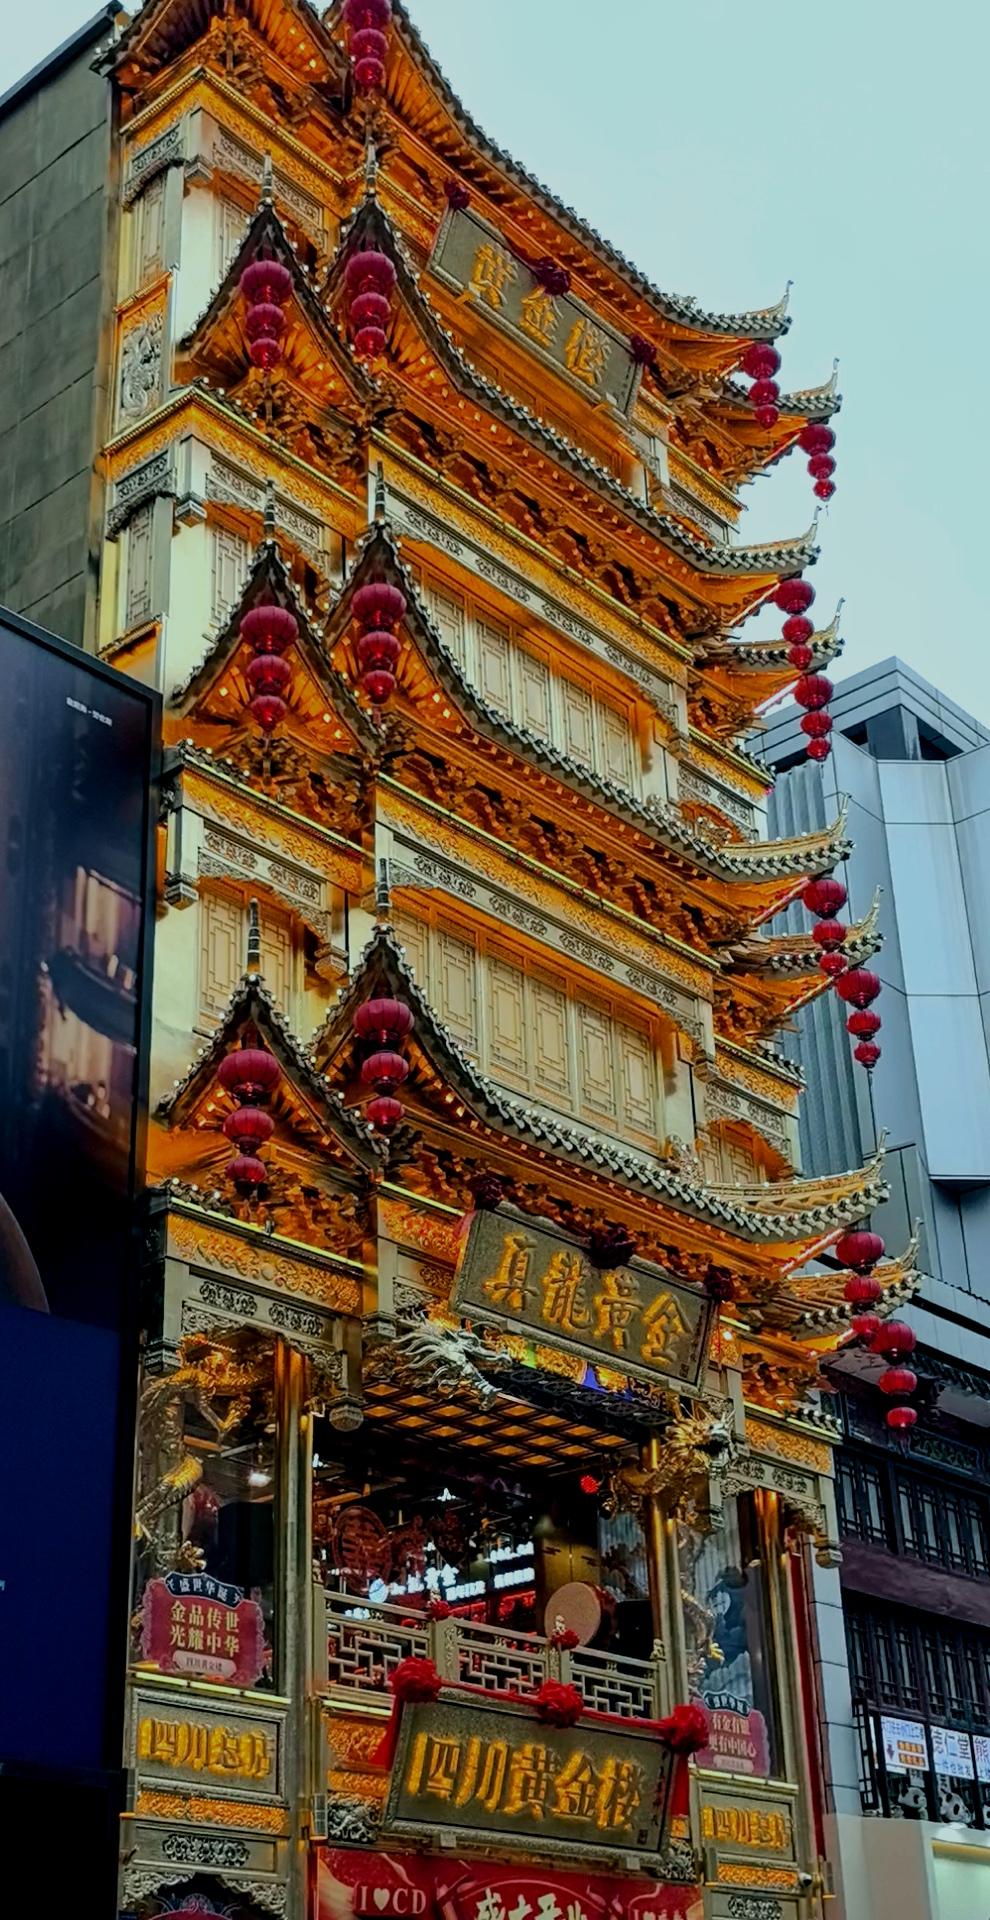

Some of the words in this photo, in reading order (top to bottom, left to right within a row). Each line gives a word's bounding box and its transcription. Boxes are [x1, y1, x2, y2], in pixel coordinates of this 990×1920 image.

[170, 1600, 241, 1633] 金品传世
[169, 1624, 241, 1659] 光耀中华
[138, 1716, 274, 1779] 四川总店
